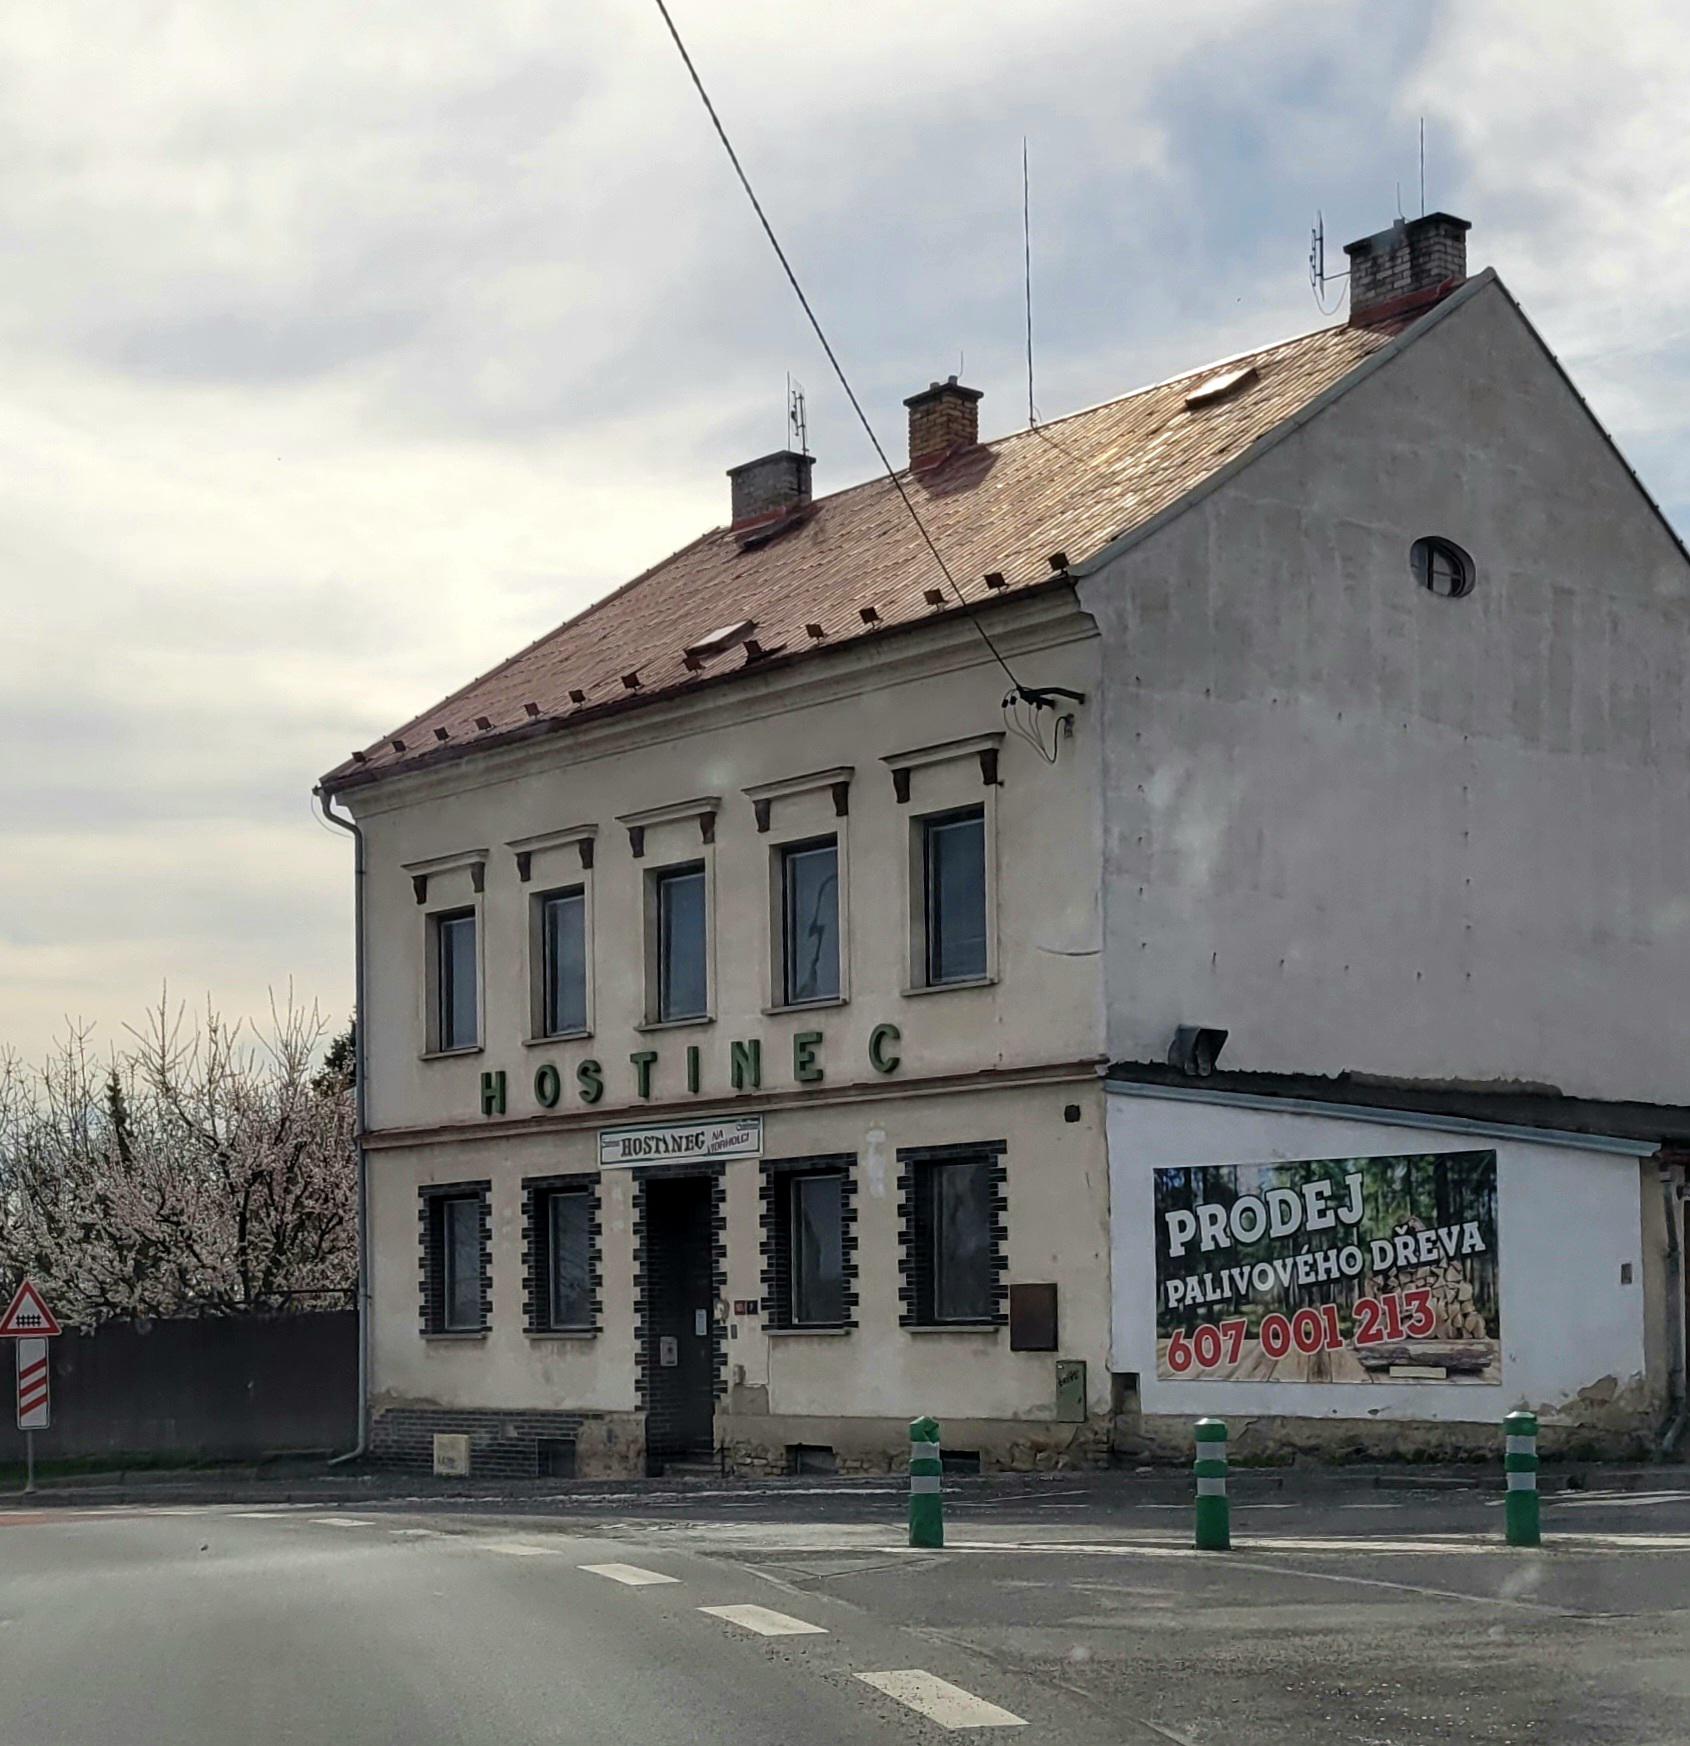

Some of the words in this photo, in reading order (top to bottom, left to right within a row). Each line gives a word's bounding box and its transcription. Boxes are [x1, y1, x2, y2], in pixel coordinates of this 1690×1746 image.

[480, 1023, 900, 1116] HOSTINEC
[712, 1129, 724, 1141] NA
[1165, 1173, 1365, 1257] PRODEJ
[1166, 1244, 1364, 1308] PALIVOVÉHO
[1370, 1221, 1486, 1271] DŘEVA
[1167, 1318, 1247, 1372] 607
[1259, 1303, 1344, 1359] 001
[1353, 1288, 1436, 1347] 213
